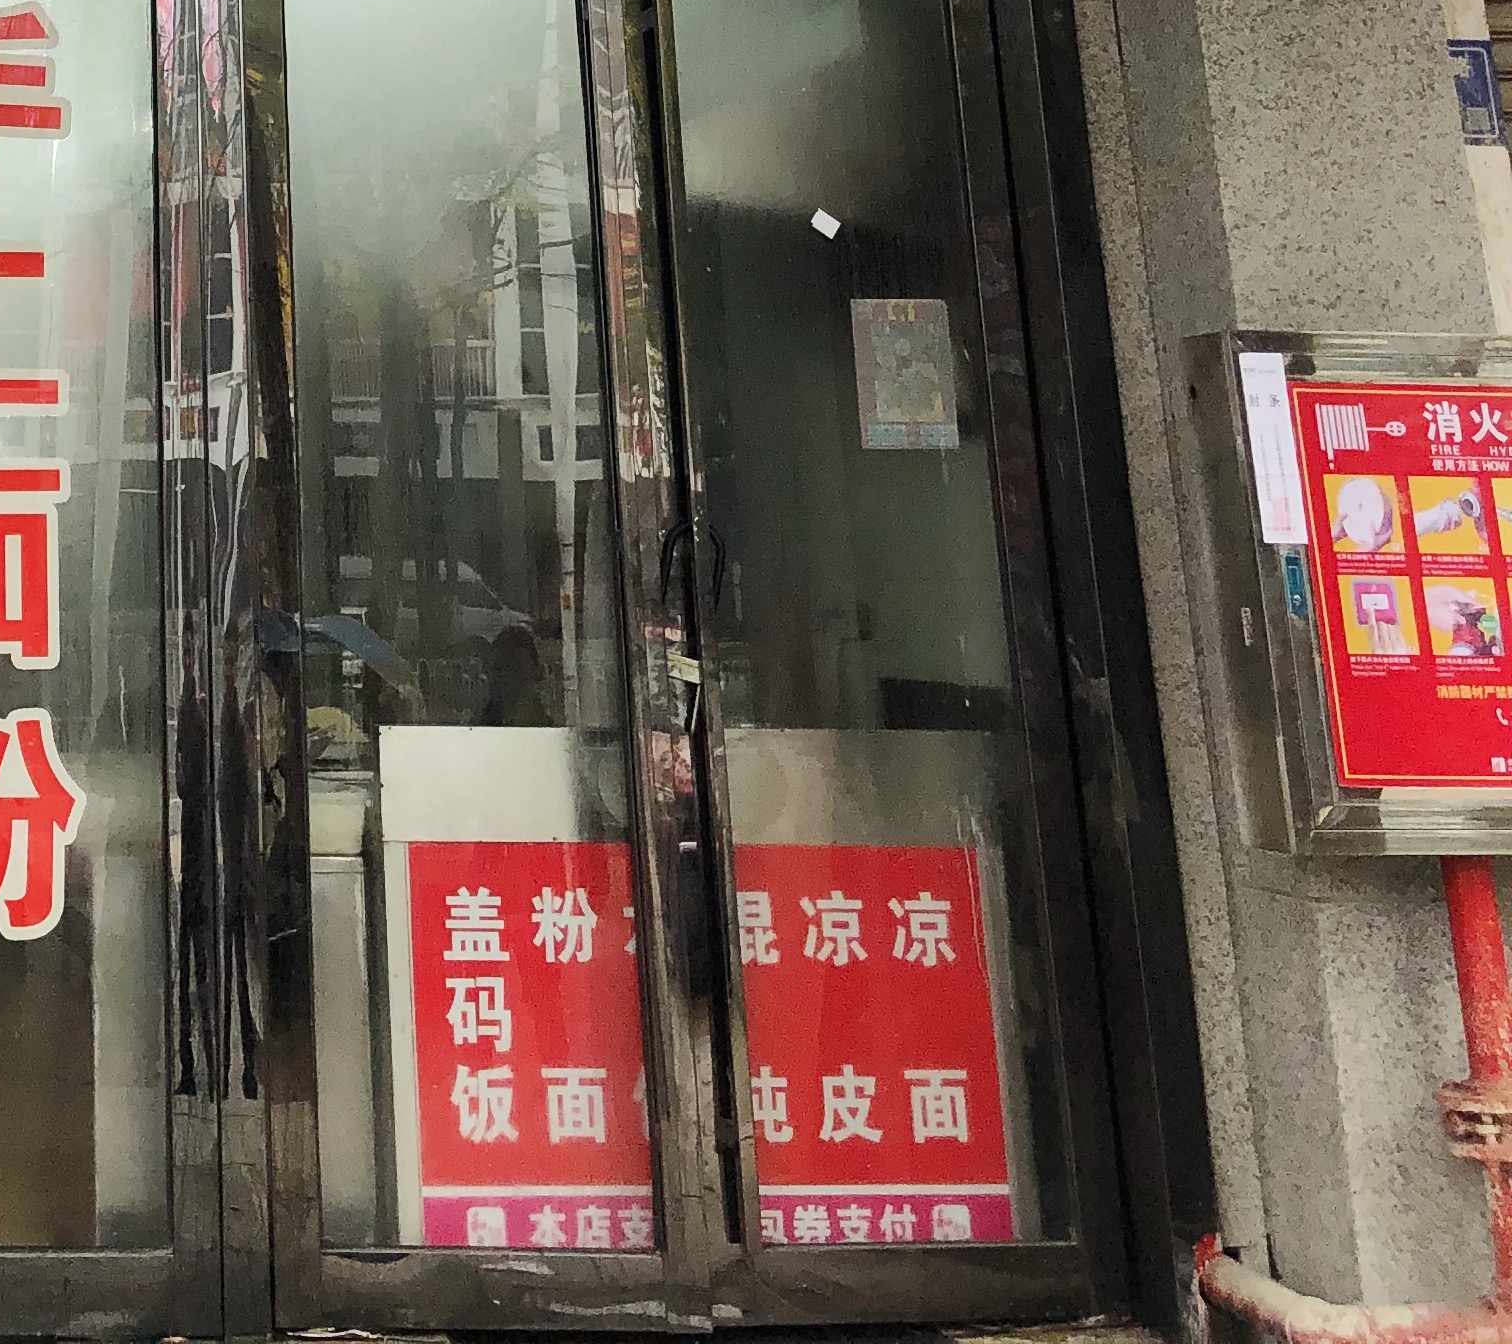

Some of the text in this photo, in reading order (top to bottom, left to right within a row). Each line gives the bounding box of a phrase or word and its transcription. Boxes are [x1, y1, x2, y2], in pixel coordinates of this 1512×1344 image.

[1423, 400, 1509, 443] 消火
[1430, 444, 1461, 455] FIRE
[1432, 458, 1510, 472] 使用方法 HOW
[443, 886, 520, 1144] 盖码饭
